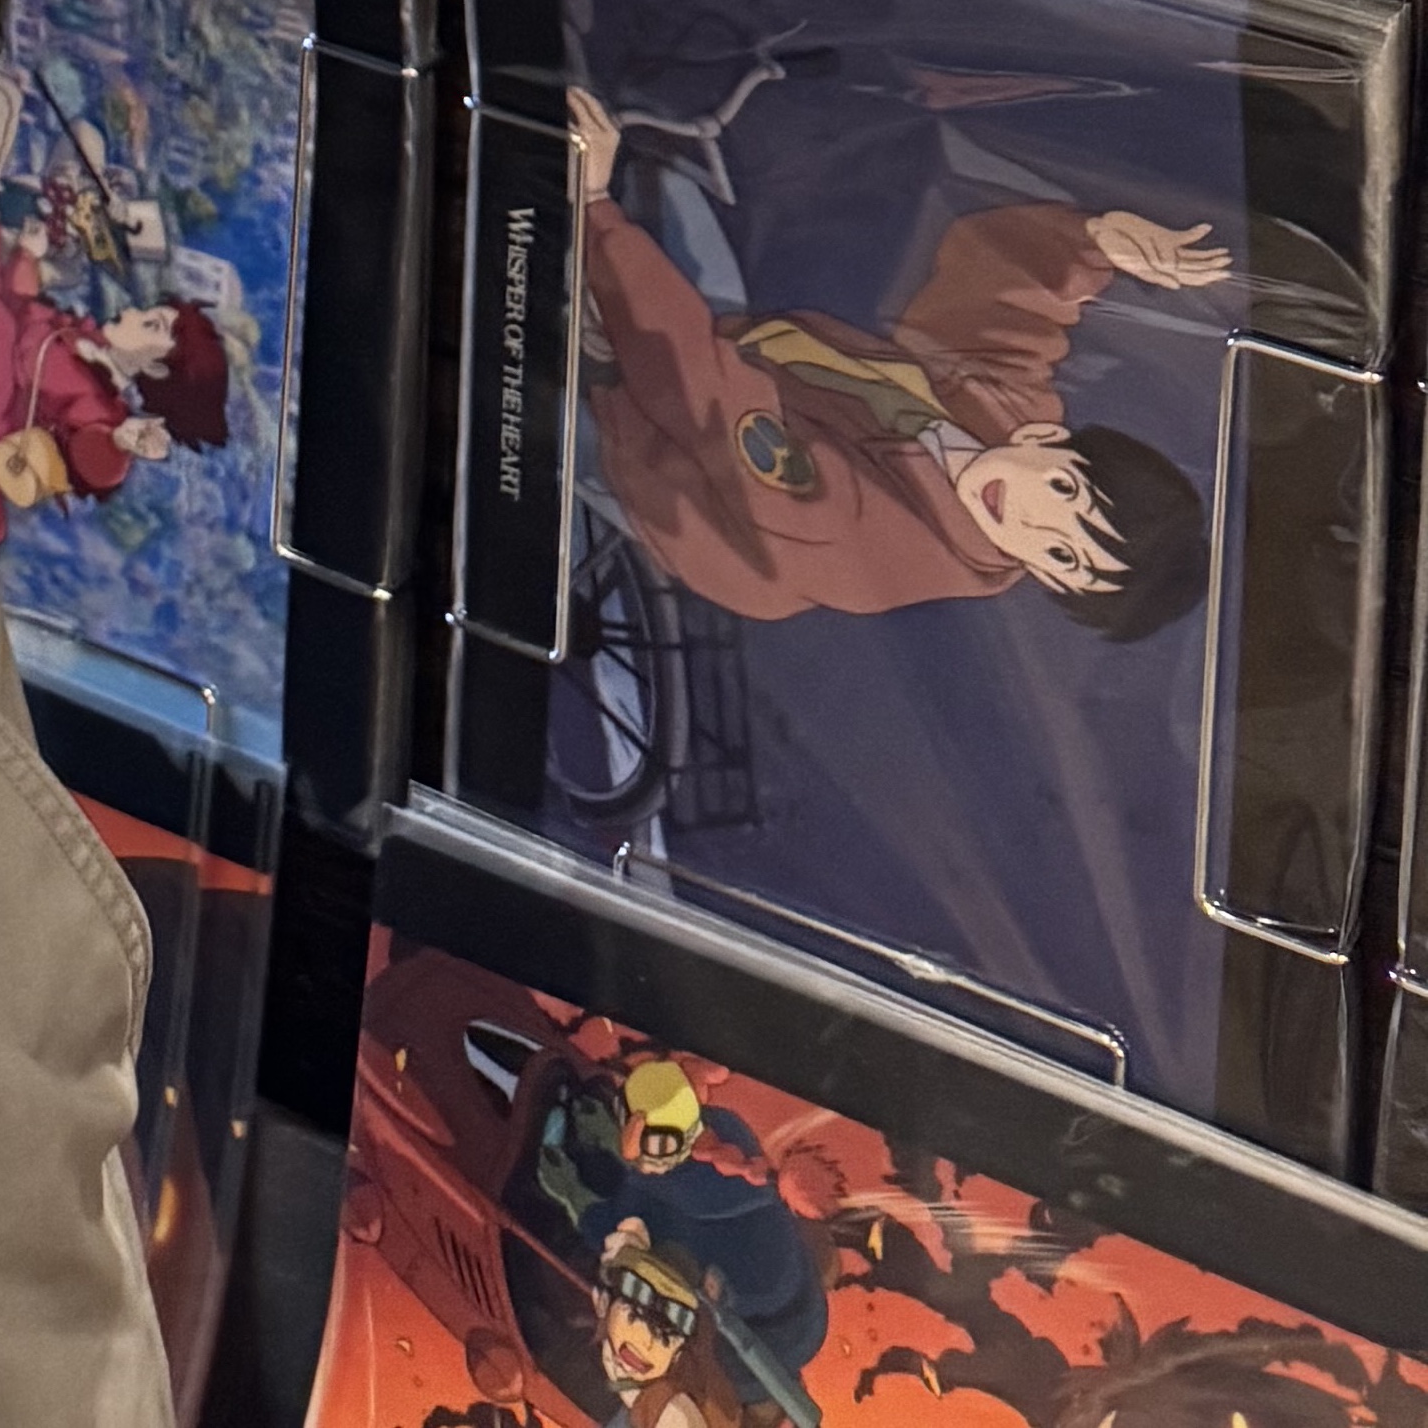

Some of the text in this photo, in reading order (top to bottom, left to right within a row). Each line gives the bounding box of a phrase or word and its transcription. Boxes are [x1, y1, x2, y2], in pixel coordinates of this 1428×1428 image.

[499, 207, 535, 502] WHISPER OF THE HEART
